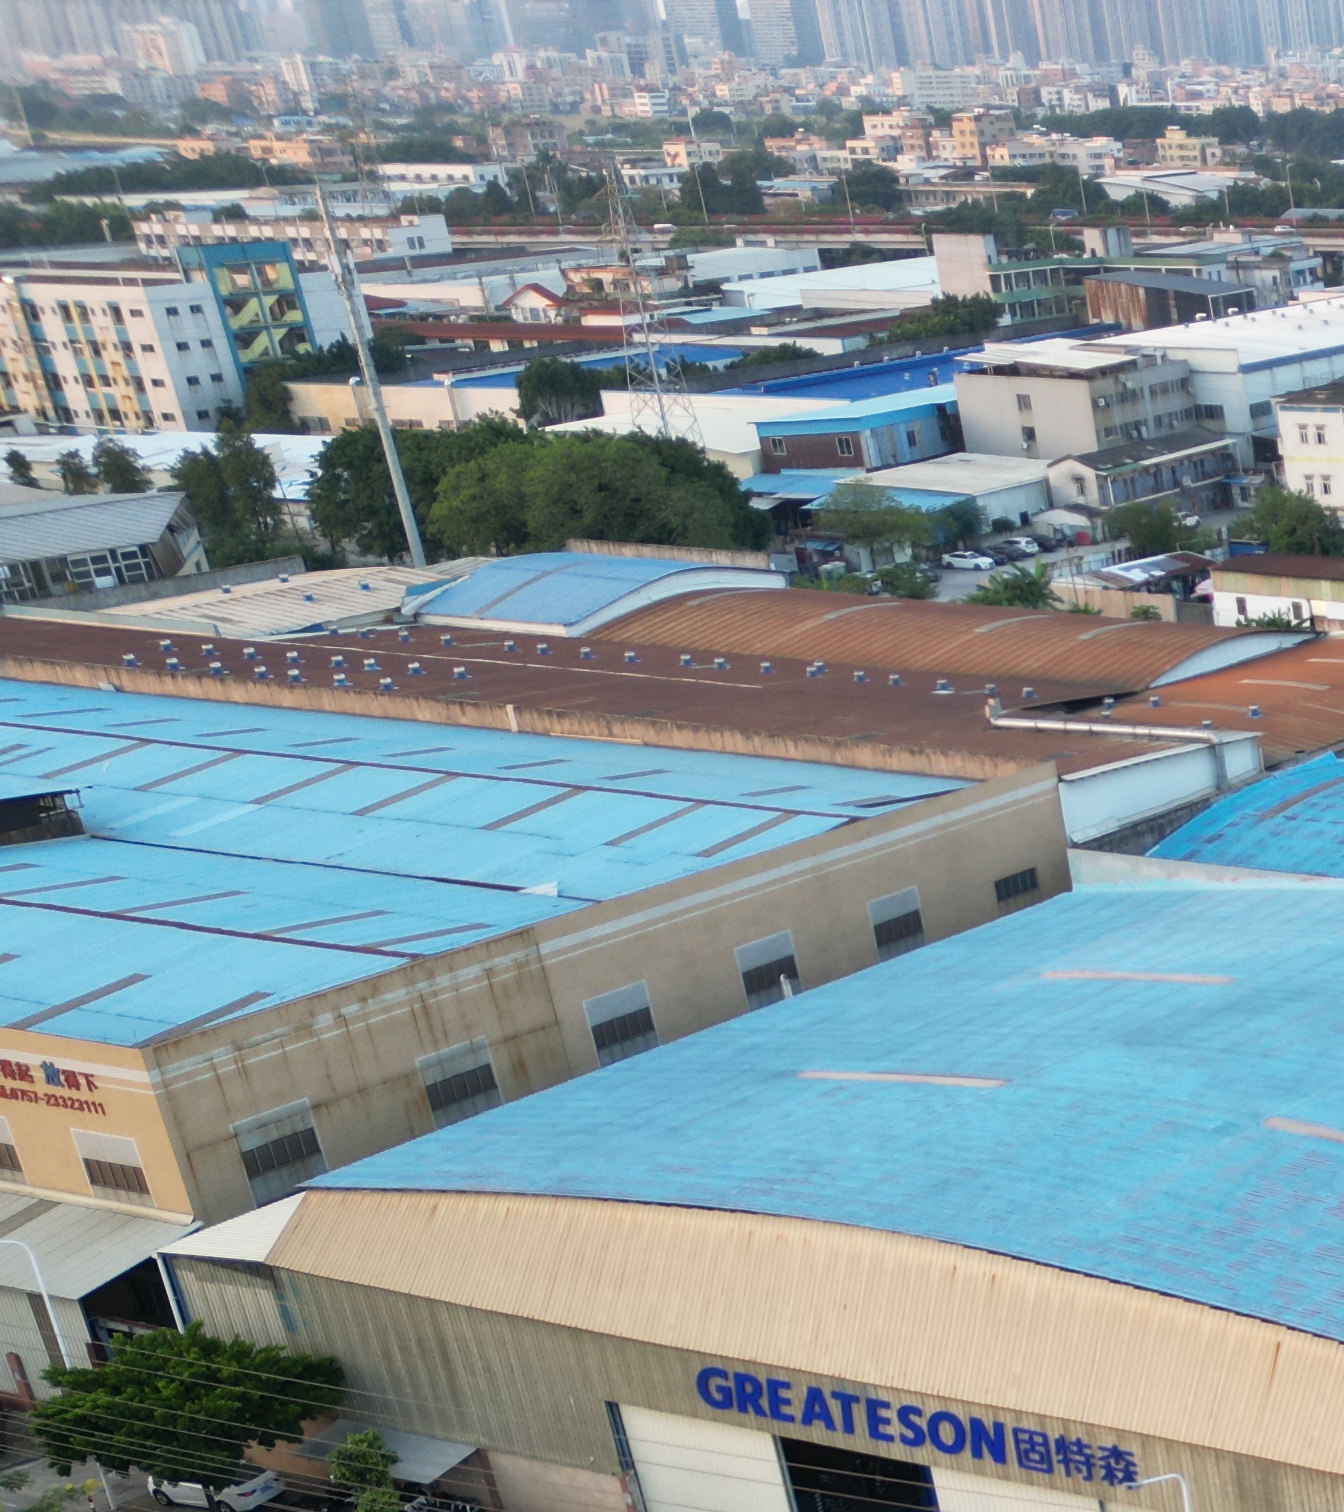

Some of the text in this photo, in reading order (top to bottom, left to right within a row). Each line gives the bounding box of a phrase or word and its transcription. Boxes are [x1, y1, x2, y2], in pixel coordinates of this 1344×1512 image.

[696, 1366, 1140, 1490] GREATESON 固特森
